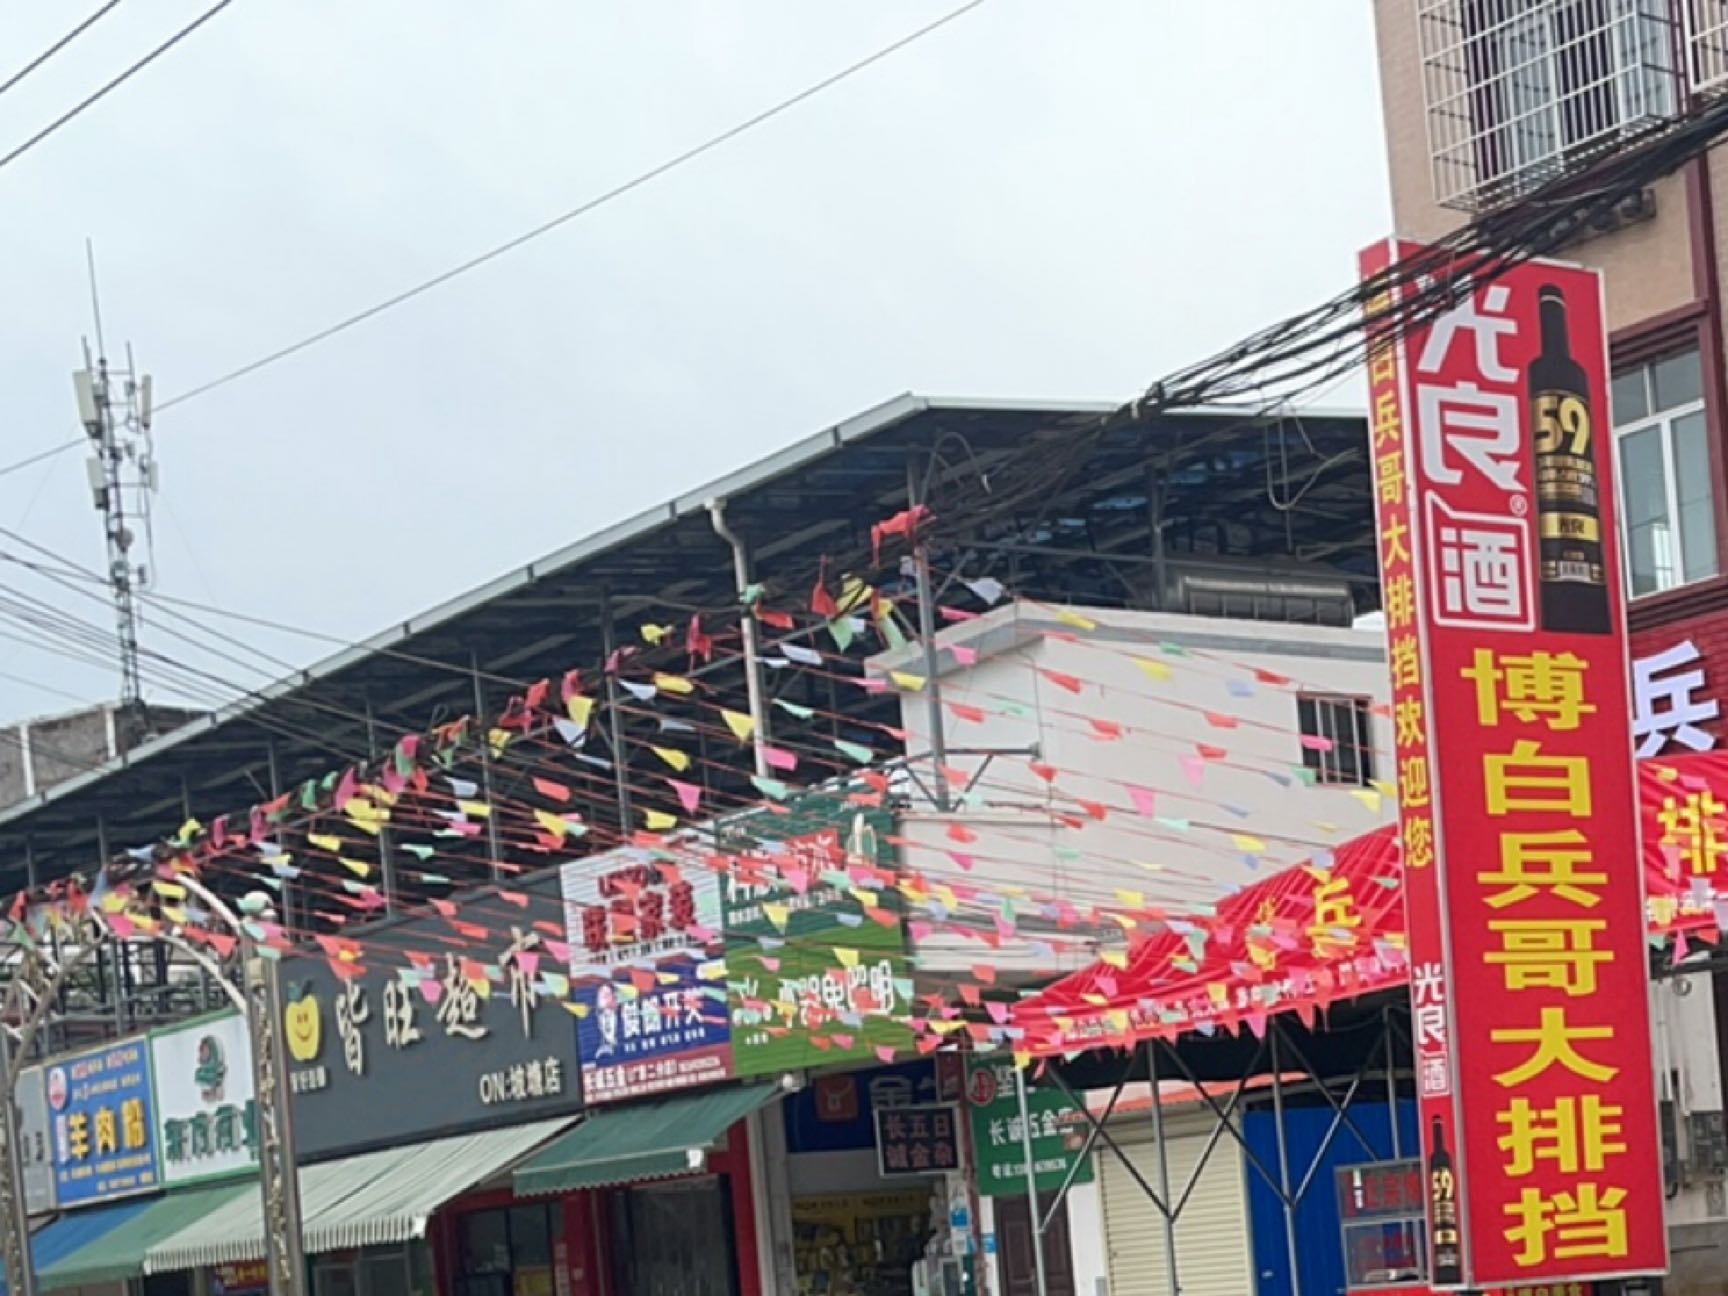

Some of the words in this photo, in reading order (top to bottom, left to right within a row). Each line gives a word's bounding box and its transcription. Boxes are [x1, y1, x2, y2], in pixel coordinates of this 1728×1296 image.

[1535, 394, 1591, 455] 59
[1461, 647, 1630, 1268] 博白兵哥大排挡
